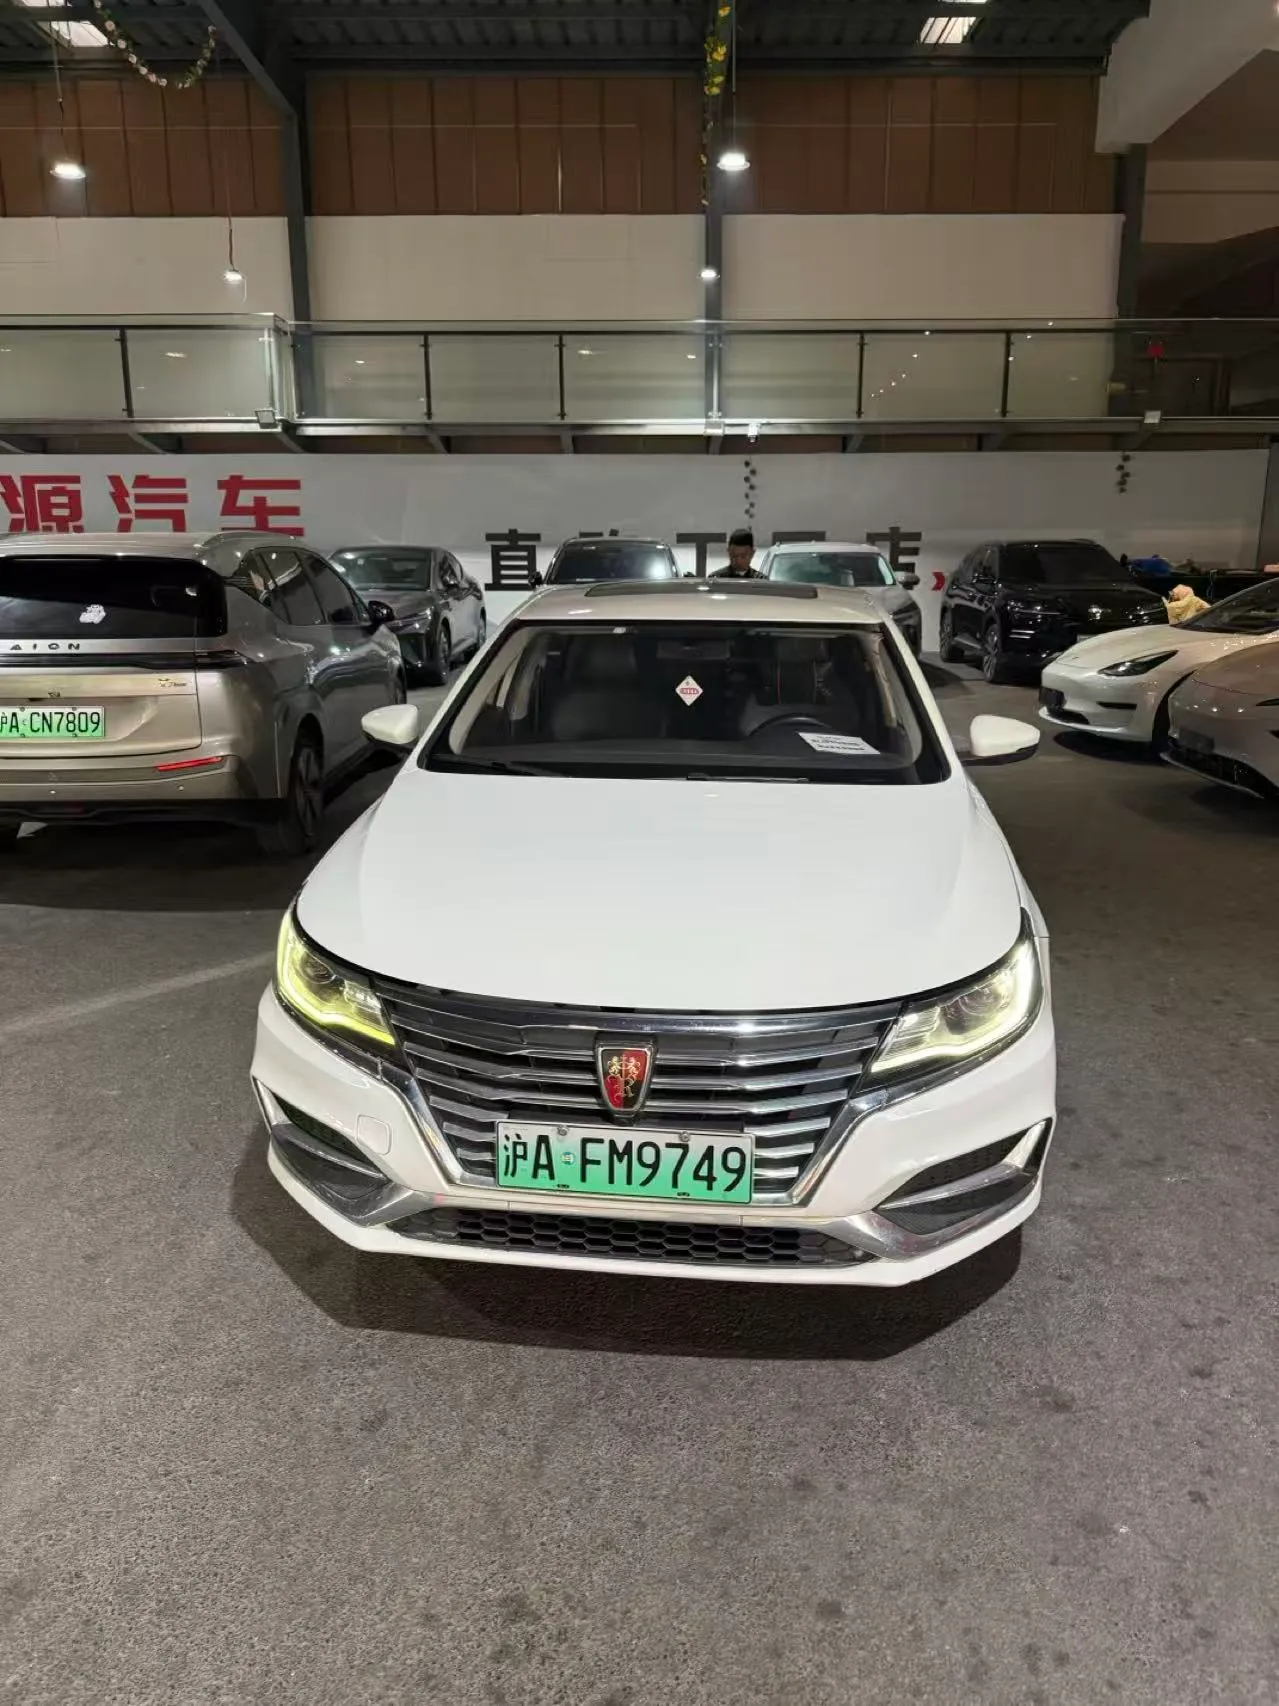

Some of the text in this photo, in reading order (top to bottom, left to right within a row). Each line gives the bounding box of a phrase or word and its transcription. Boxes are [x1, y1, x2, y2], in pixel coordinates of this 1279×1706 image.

[0, 474, 305, 536] 源汽车
[10, 642, 81, 651] AION
